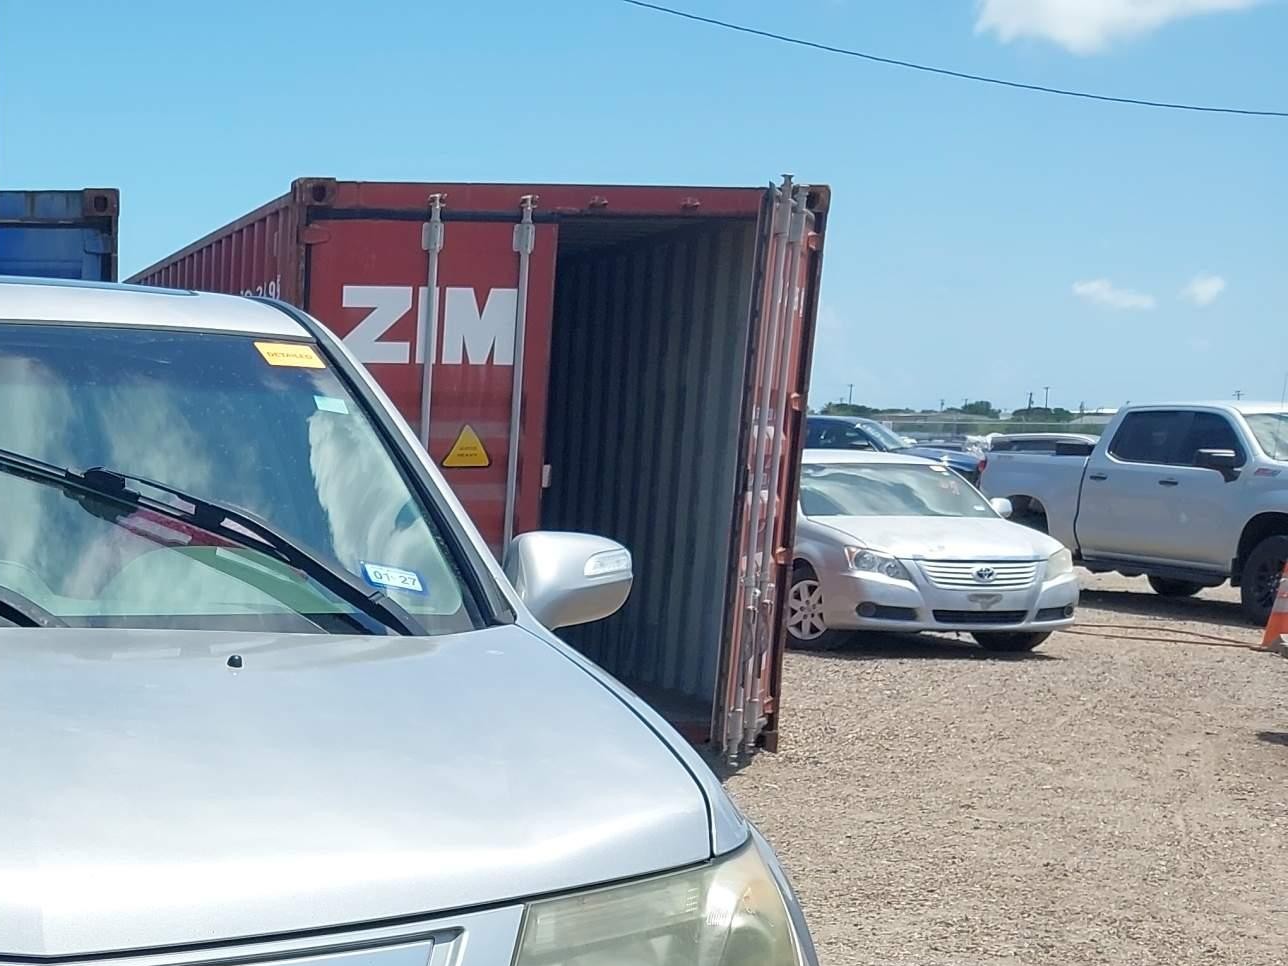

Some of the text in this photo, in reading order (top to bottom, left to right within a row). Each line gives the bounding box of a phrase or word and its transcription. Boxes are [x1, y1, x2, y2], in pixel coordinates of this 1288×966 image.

[342, 285, 518, 366] ZIM
[373, 570, 417, 586] 01 27
